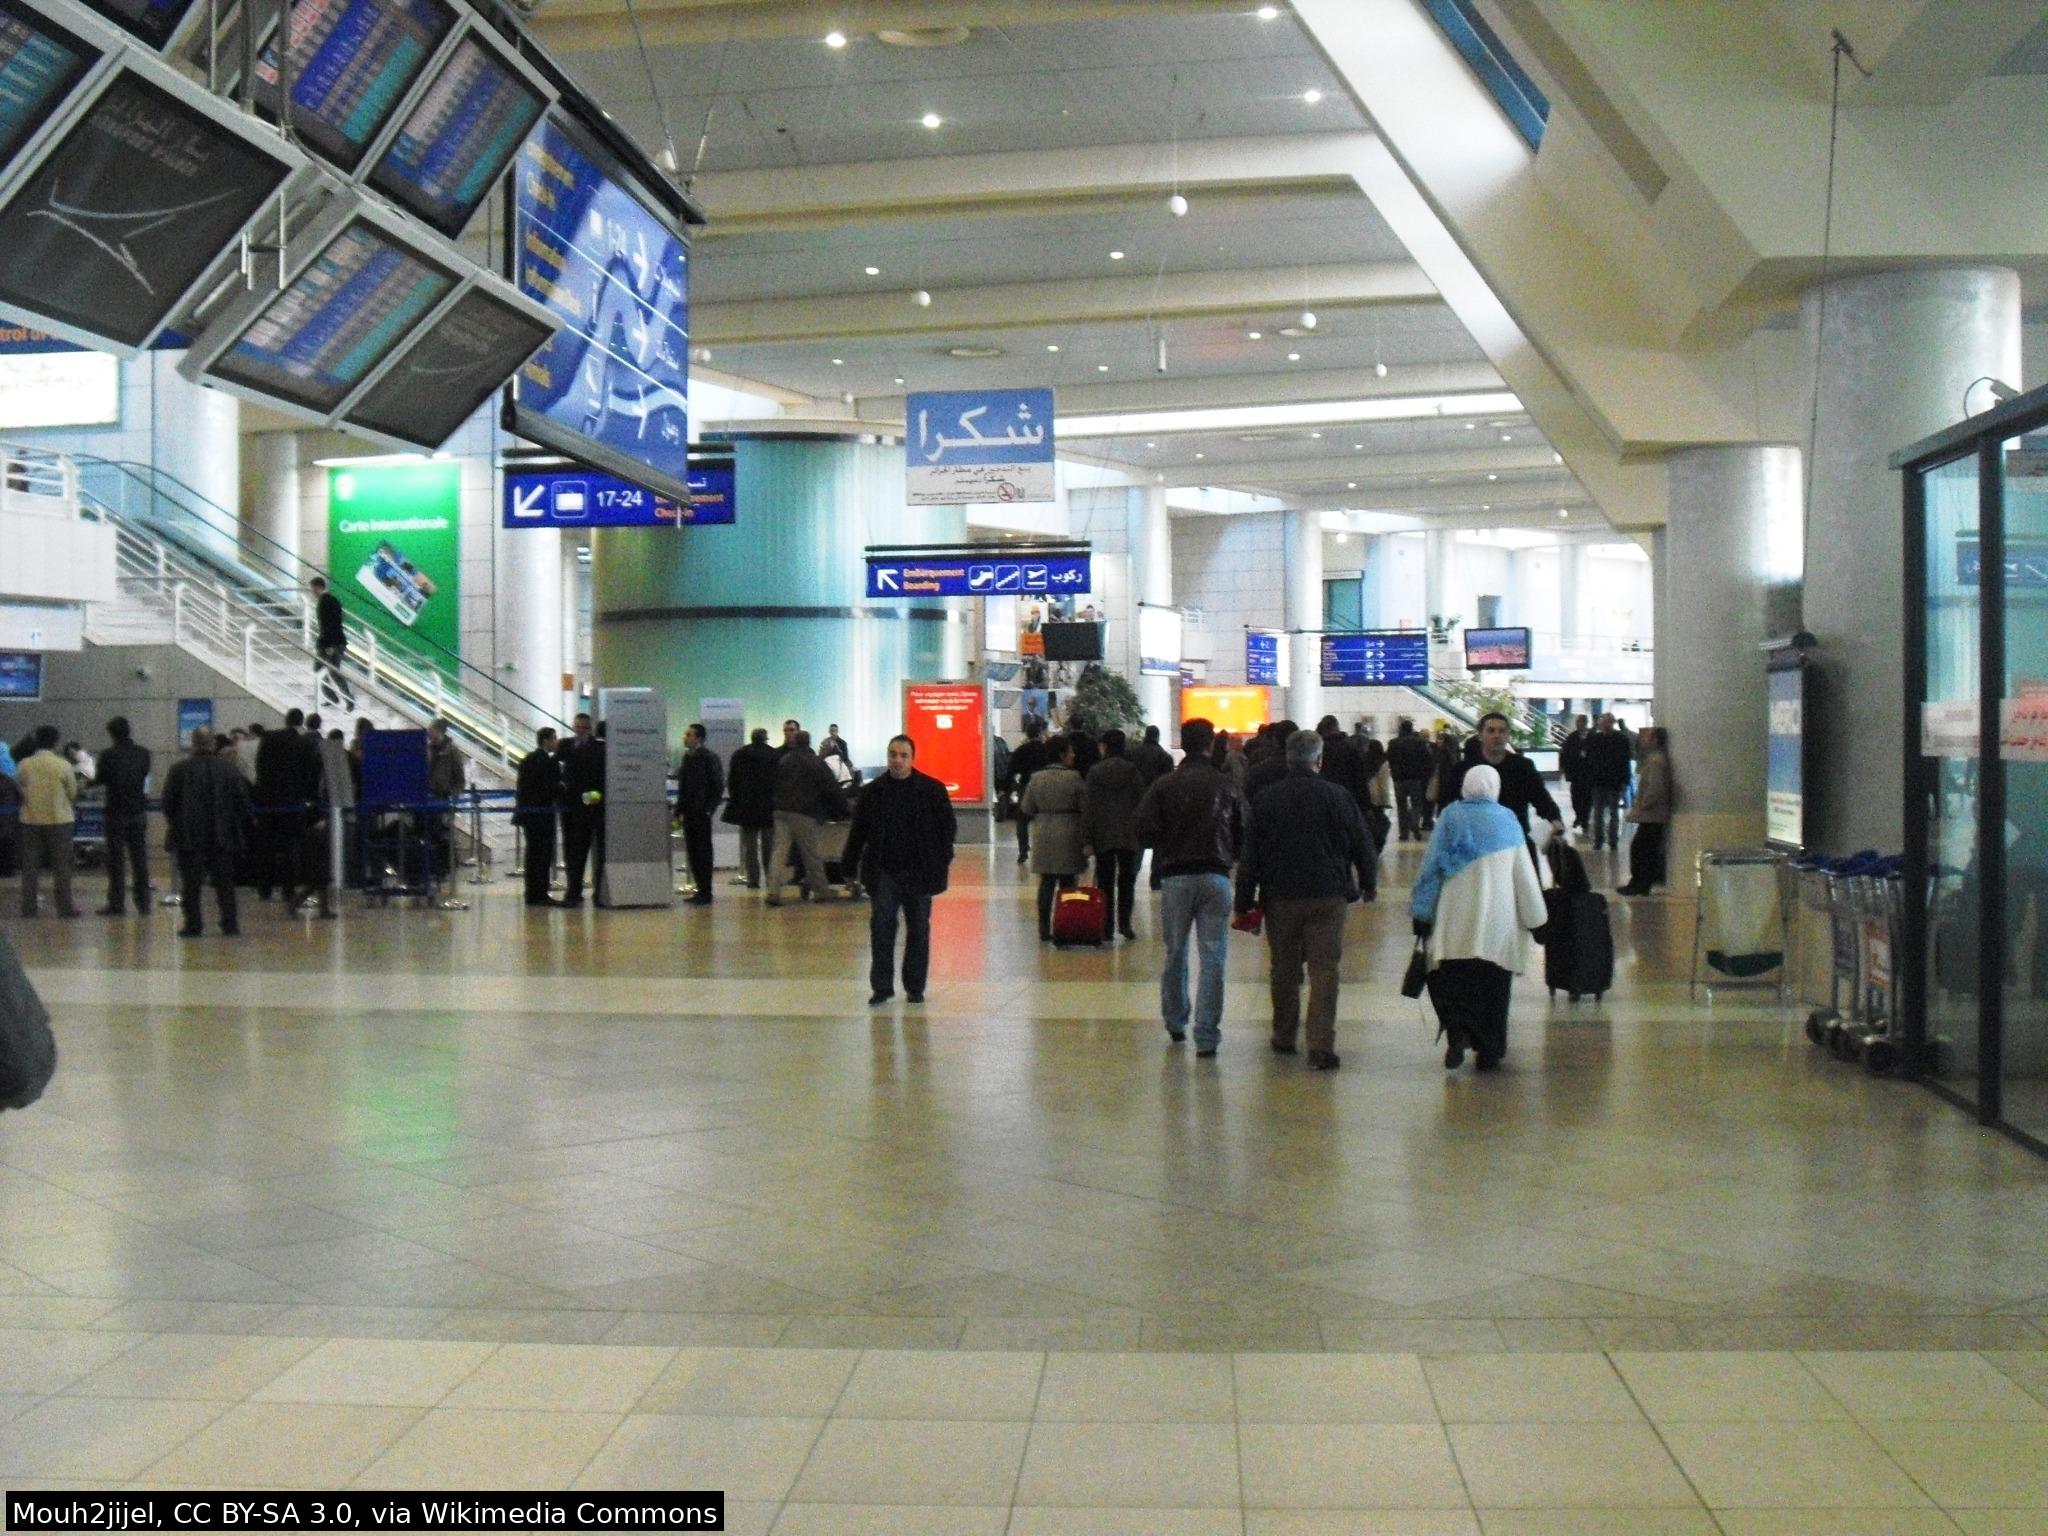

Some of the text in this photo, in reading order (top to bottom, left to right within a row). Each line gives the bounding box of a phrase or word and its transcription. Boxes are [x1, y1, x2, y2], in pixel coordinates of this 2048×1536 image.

[919, 403, 1044, 461] شكرا
[597, 491, 642, 507] 17-24
[1051, 569, 1083, 583] ركوب
